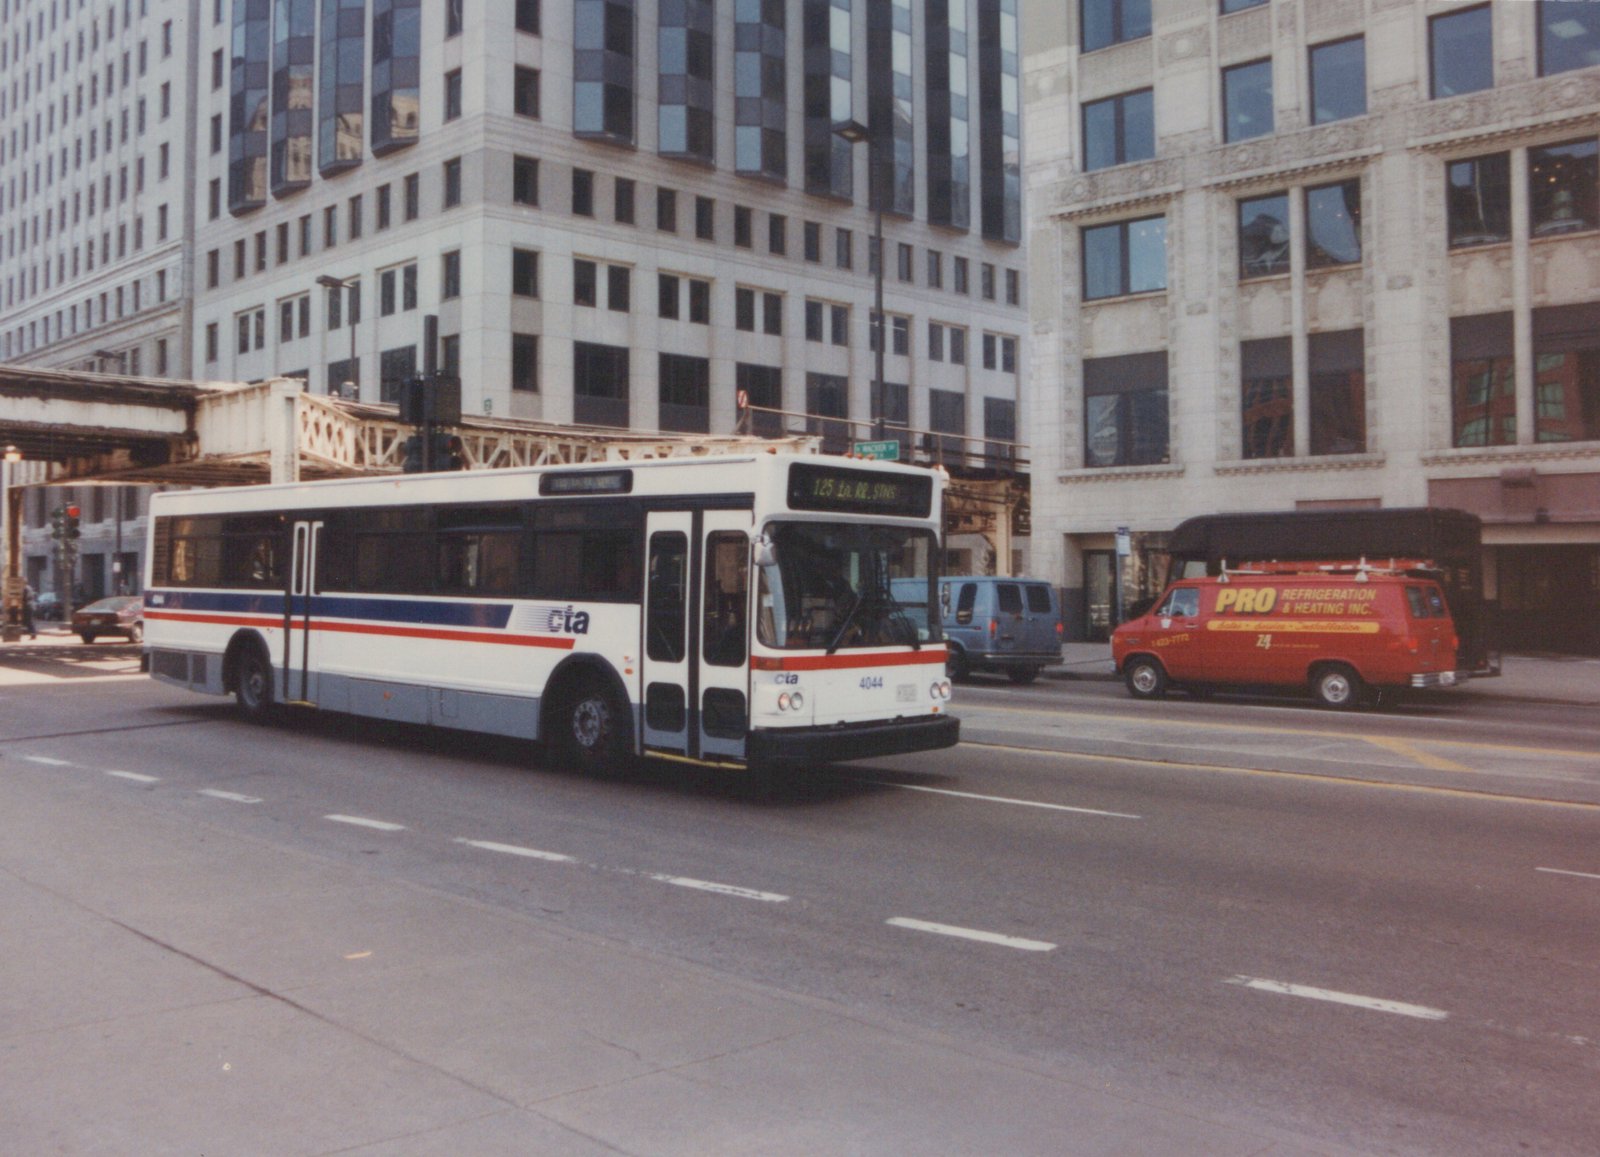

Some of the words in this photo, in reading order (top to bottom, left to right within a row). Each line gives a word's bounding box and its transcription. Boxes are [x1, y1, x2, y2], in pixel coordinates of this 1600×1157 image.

[813, 478, 834, 495] 125
[1215, 587, 1277, 613] PRO
[1282, 588, 1377, 601] REFRIGERATION
[1282, 603, 1290, 614] &
[1294, 602, 1344, 615] HEATING
[1347, 603, 1373, 615] INC.
[548, 604, 590, 634] cta
[774, 672, 798, 685] cta
[859, 676, 883, 690] 4044
